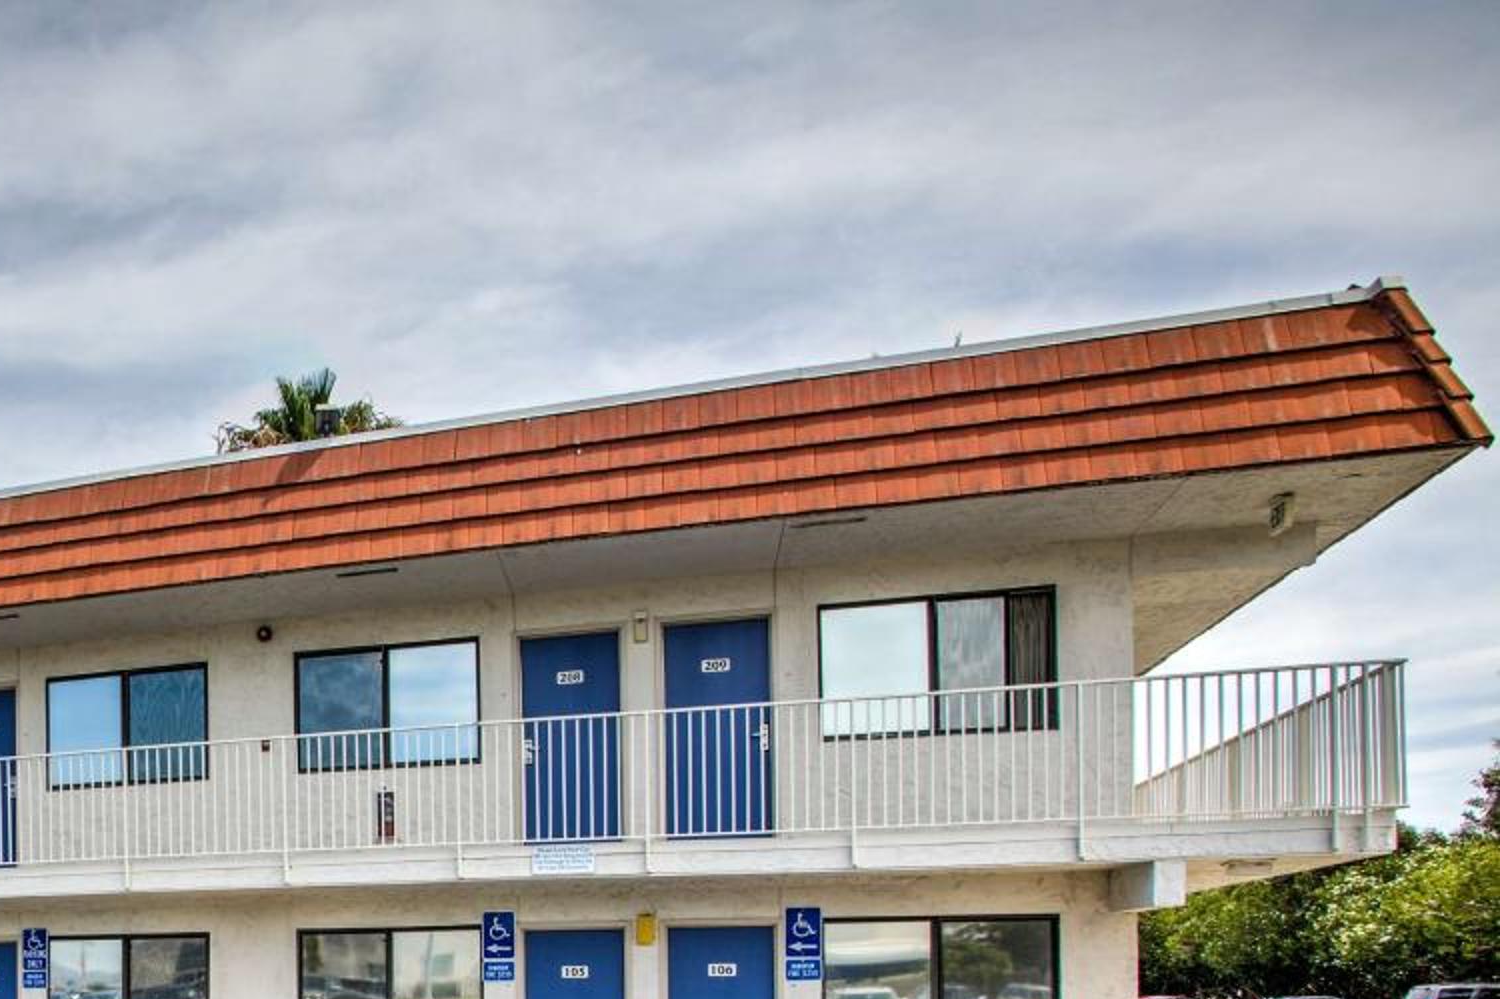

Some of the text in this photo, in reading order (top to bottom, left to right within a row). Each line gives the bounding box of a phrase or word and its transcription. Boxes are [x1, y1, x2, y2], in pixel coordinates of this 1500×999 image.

[705, 660, 727, 671] 209
[564, 967, 585, 977] 105
[711, 965, 733, 975] 106
